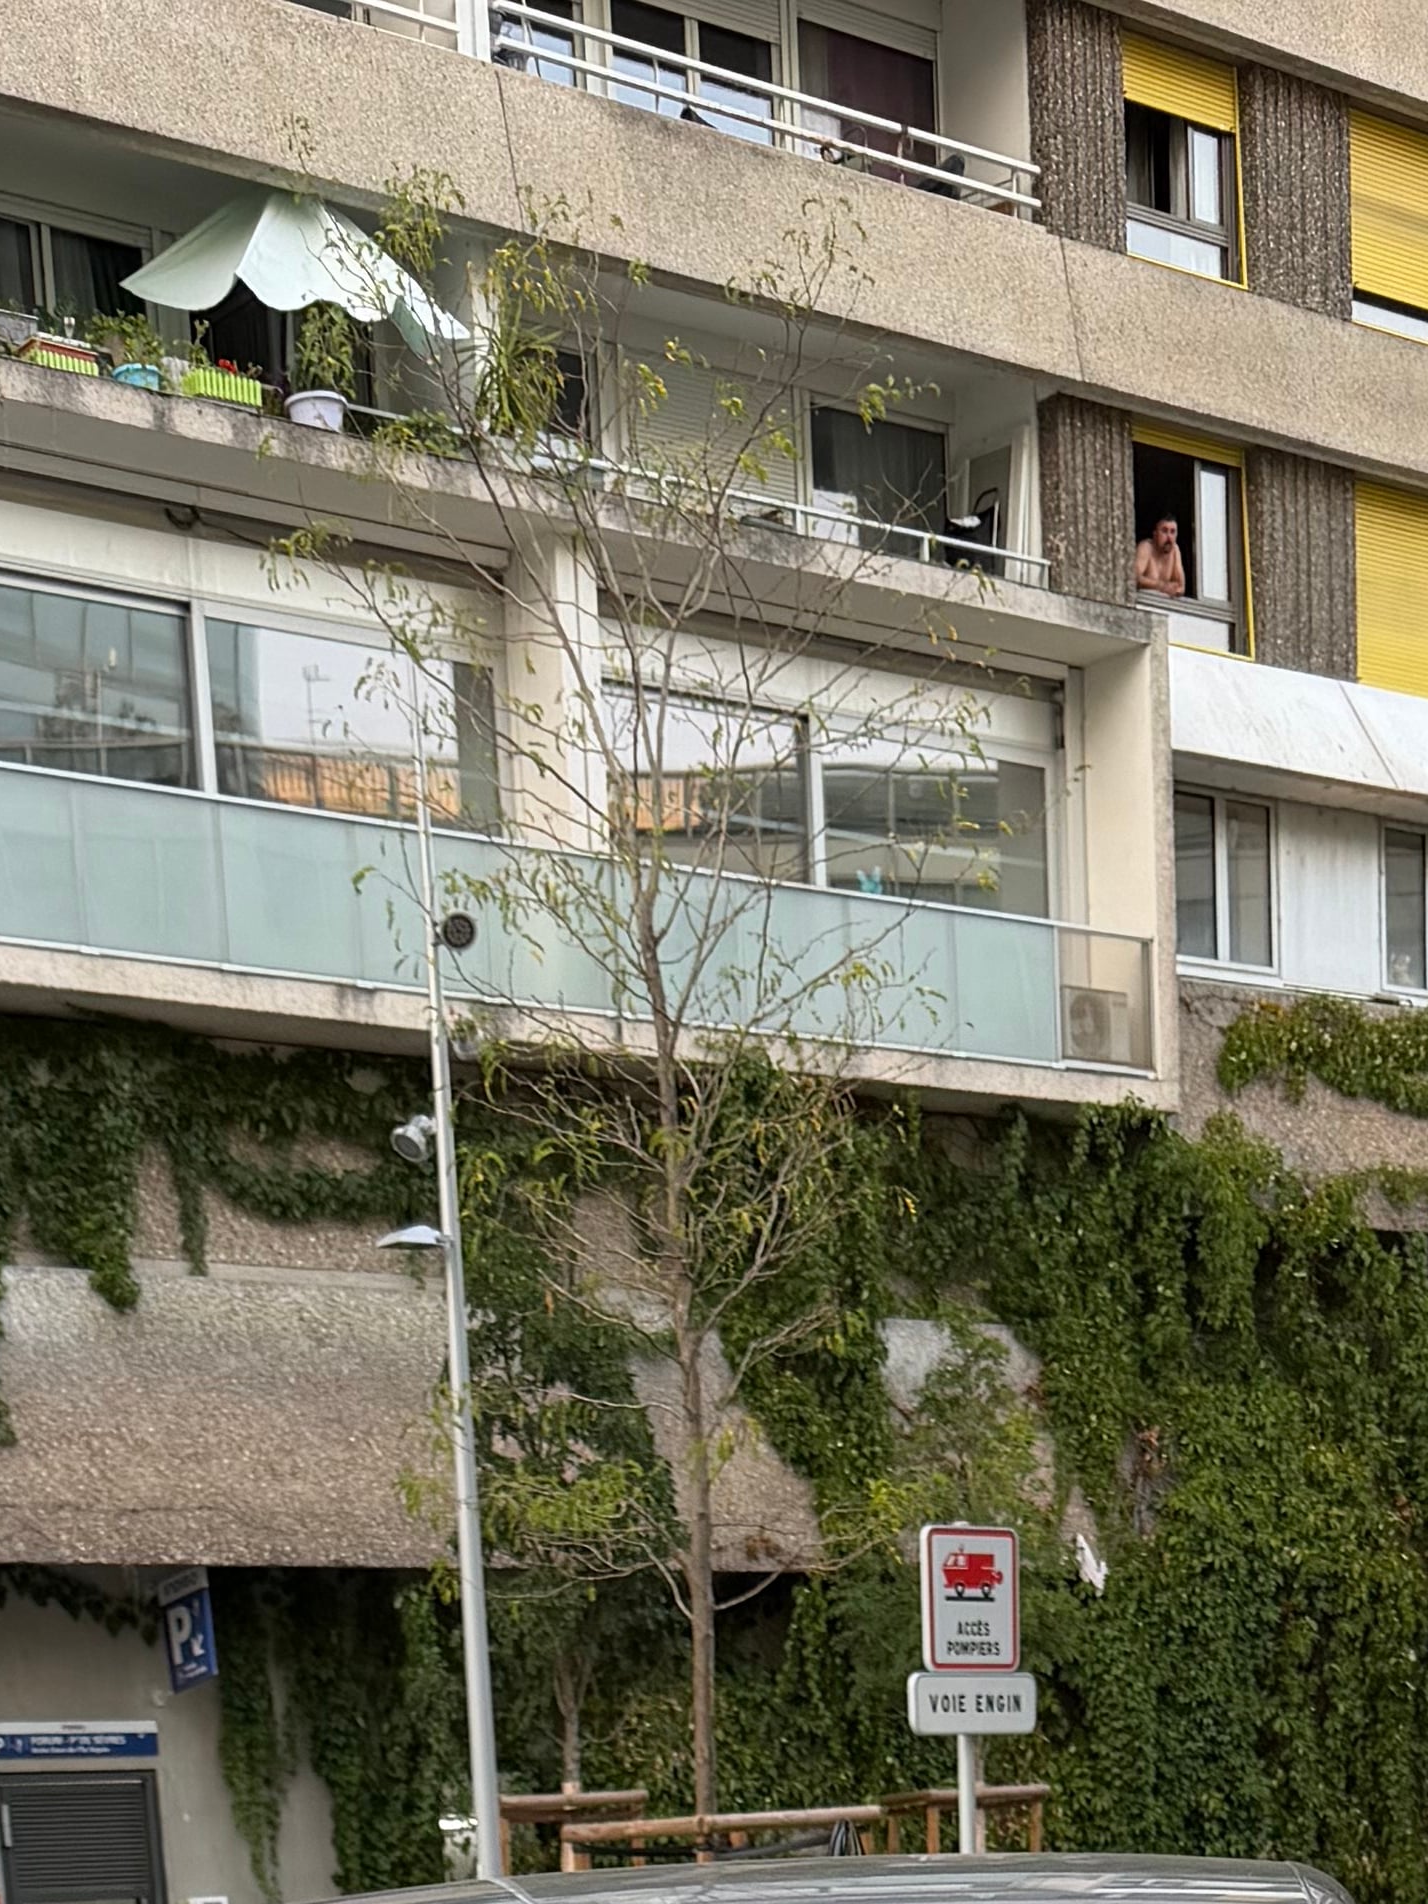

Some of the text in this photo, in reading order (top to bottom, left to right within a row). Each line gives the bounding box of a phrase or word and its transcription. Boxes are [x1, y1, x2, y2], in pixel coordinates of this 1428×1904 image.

[166, 1606, 192, 1665] P
[957, 1620, 991, 1636] ACCÈS
[947, 1641, 1001, 1657] POMPIERS
[929, 1694, 1022, 1713] VOIE ENGIN
